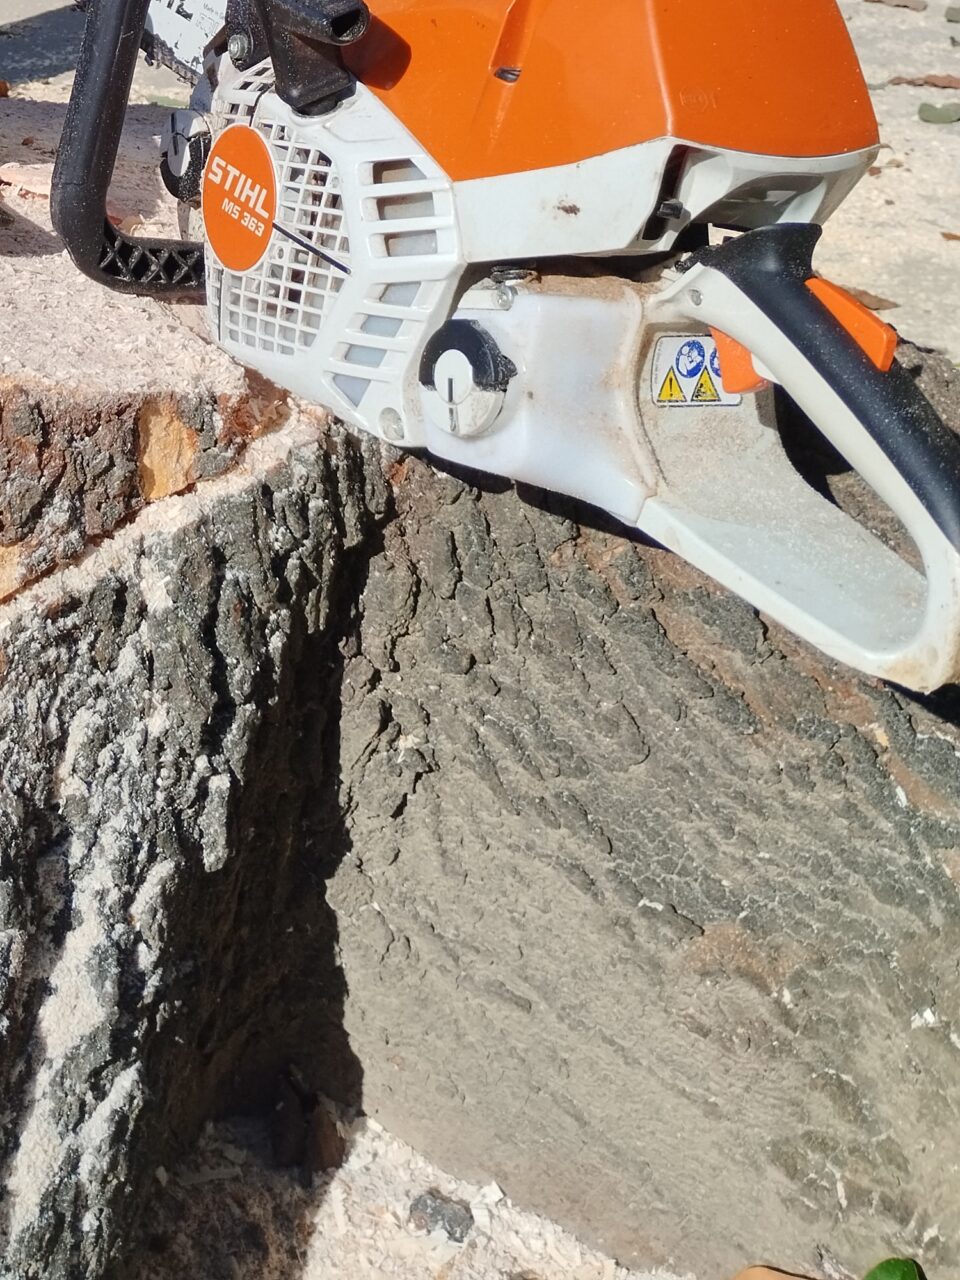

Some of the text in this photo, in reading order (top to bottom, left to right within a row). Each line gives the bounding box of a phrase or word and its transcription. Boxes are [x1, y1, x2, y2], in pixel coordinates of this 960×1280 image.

[208, 156, 269, 219] STIHL
[221, 197, 265, 237] MS 363
